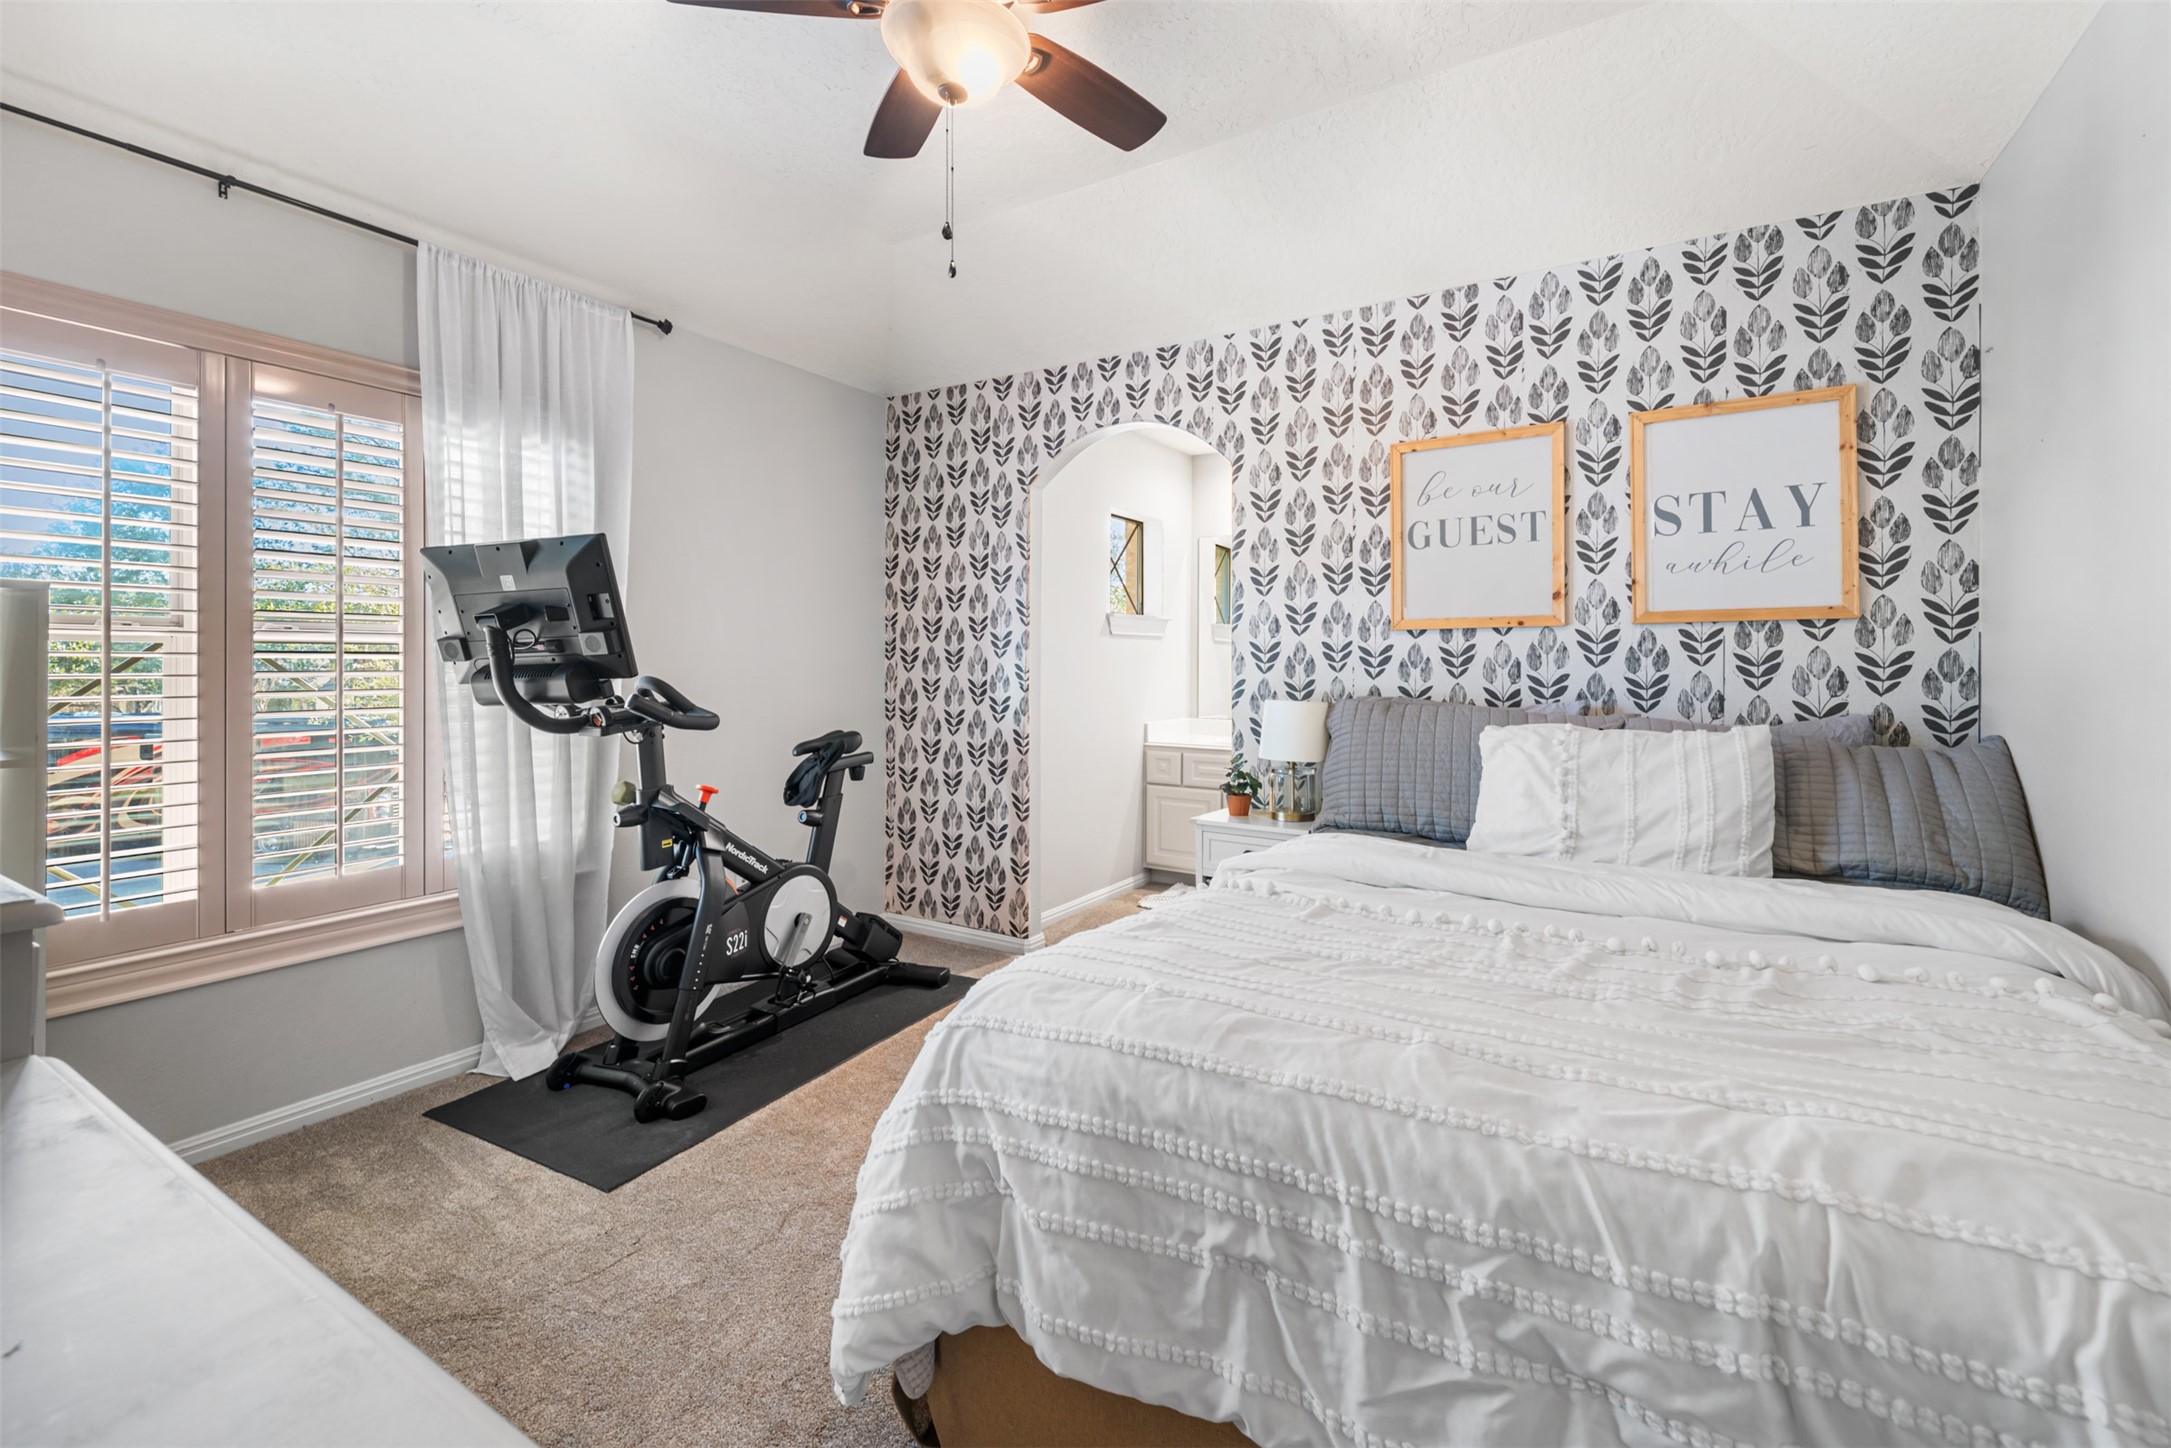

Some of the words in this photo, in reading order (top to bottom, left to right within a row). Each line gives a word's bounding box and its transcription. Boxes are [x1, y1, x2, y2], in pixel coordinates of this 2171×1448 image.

[1417, 470, 1462, 507] be
[1471, 477, 1535, 498] our
[1653, 482, 1828, 537] STAY
[1407, 510, 1547, 550] GUEST
[1665, 538, 1815, 575] awhile
[725, 841, 769, 874] NordicTrack
[726, 929, 748, 956] S22i
